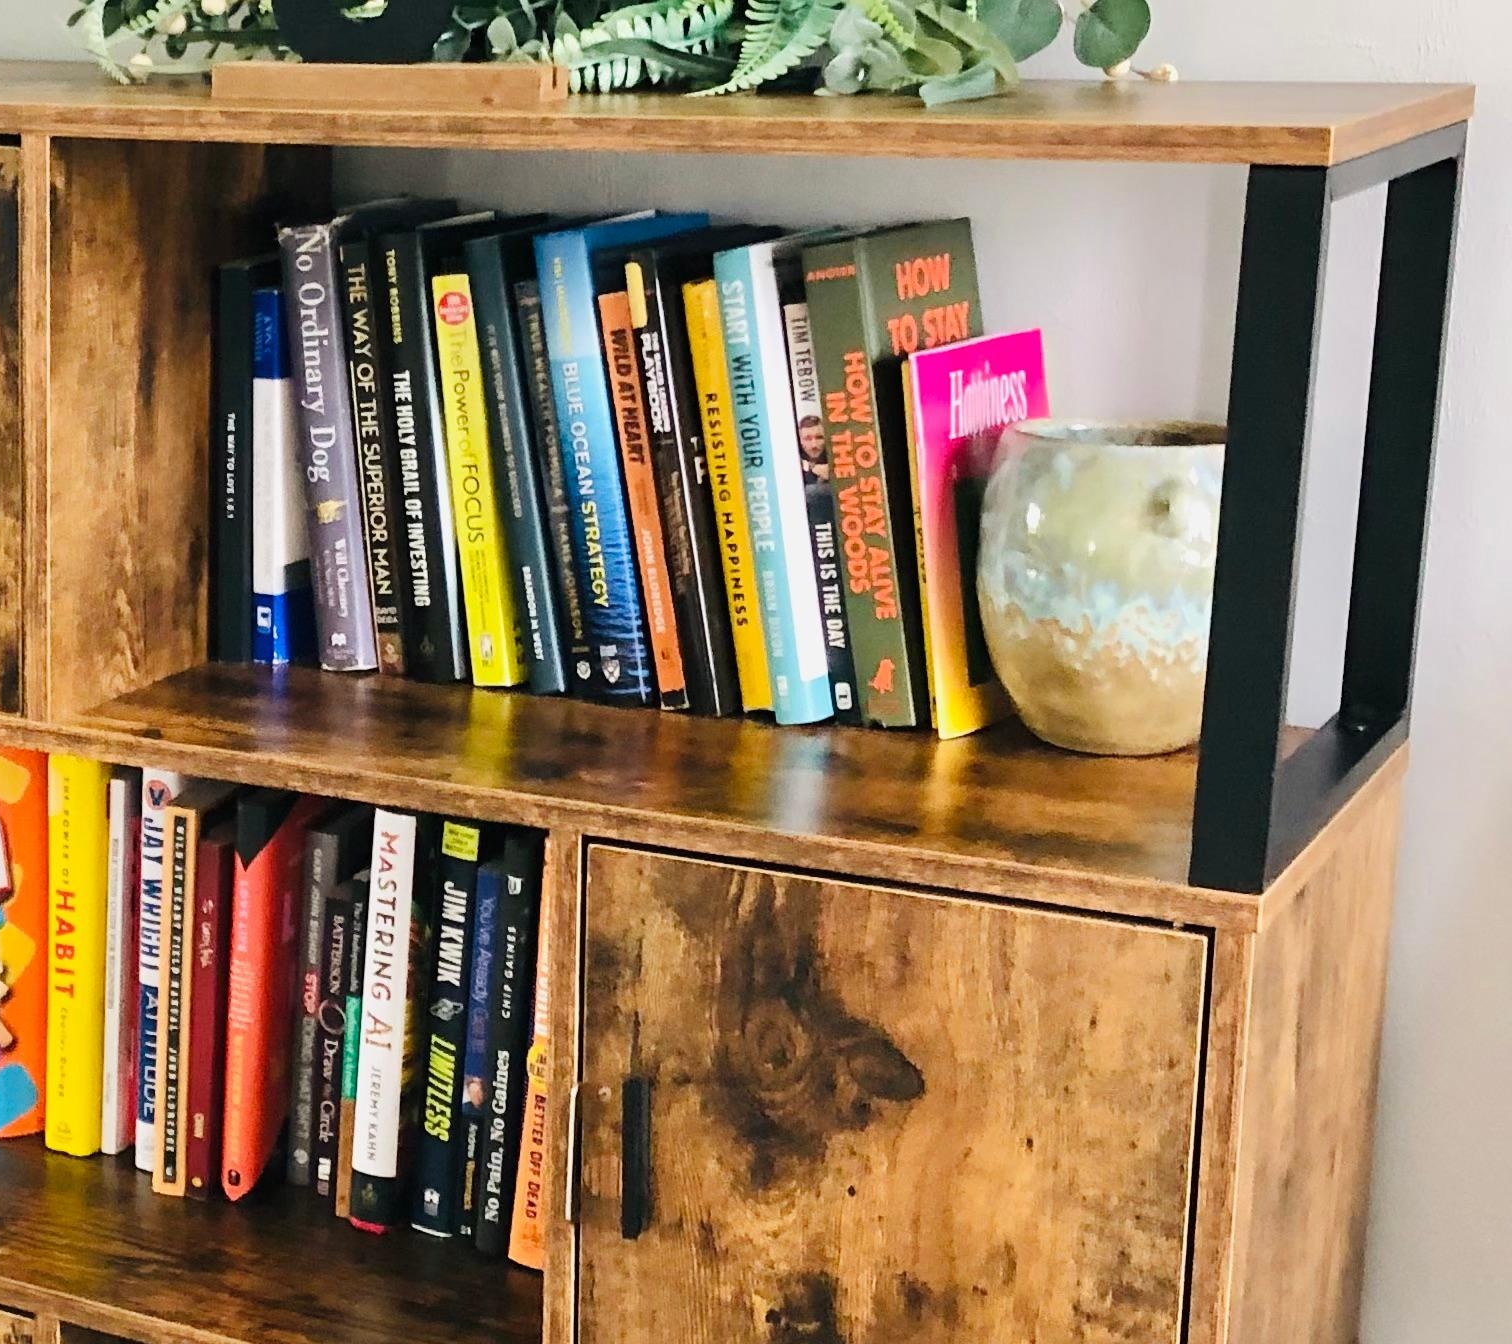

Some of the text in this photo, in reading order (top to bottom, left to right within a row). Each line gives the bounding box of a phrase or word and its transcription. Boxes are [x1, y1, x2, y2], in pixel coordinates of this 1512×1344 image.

[386, 249, 403, 345] TONY ROBBINS
[894, 253, 951, 300] HOW
[295, 226, 336, 483] No Ordinary Dog
[448, 330, 467, 368] The
[610, 328, 632, 376] WILD
[887, 300, 970, 356] TO STAY
[640, 332, 664, 434] PLAYBOOK
[791, 316, 817, 403] TIM TEBOW
[452, 368, 470, 436] Power
[618, 381, 637, 404] AT
[722, 279, 776, 553] START WITH YOUR PEOPLE
[348, 263, 393, 595] THE WAY OF THE SUPERIOR MAN
[458, 437, 476, 464] of
[621, 409, 645, 465] HEART
[393, 370, 431, 607] THE HOLY GRAIL OF INVESTING
[462, 463, 484, 544] FOCUS
[562, 361, 609, 608] BLUE OCEAN STRATEGY
[705, 393, 748, 627] RESISTING HAPPINESS
[825, 391, 871, 595] IN THE WOODS
[844, 350, 898, 621] HOW TO STAY ALIVE
[334, 539, 347, 564] Will
[641, 527, 656, 565] JOHN
[521, 566, 537, 617] BRANDON
[533, 631, 545, 661] WEST
[647, 567, 666, 634] ELDREDGE
[814, 522, 846, 649] THIS IS THE DAY
[143, 816, 164, 866] JAY
[175, 825, 185, 857] WILD
[312, 848, 322, 883] GARY
[174, 865, 184, 880] AT
[172, 887, 183, 931] HEART
[442, 880, 468, 924] JIM
[55, 888, 76, 999] HABIT
[170, 935, 182, 975] FIELD
[330, 914, 345, 994] BATTERSON
[437, 925, 465, 987] KWIK
[304, 972, 318, 1014] STOP
[365, 830, 400, 1162] MASTERING AI JEREMY KAHN
[472, 947, 493, 1004] Already
[501, 926, 517, 1019] CHIP GAINES
[168, 981, 180, 1031] MANUAL
[167, 1047, 178, 1080] JOHN
[321, 1038, 338, 1081] Draw
[492, 1049, 510, 1115] Gaines
[424, 1033, 457, 1143] LIMITLESS
[318, 1100, 336, 1143] Circle
[490, 1117, 505, 1142] No
[531, 1094, 547, 1145] BETTER
[529, 1151, 543, 1182] OFF
[485, 1196, 500, 1223] No
[526, 1183, 541, 1219] DEAD
